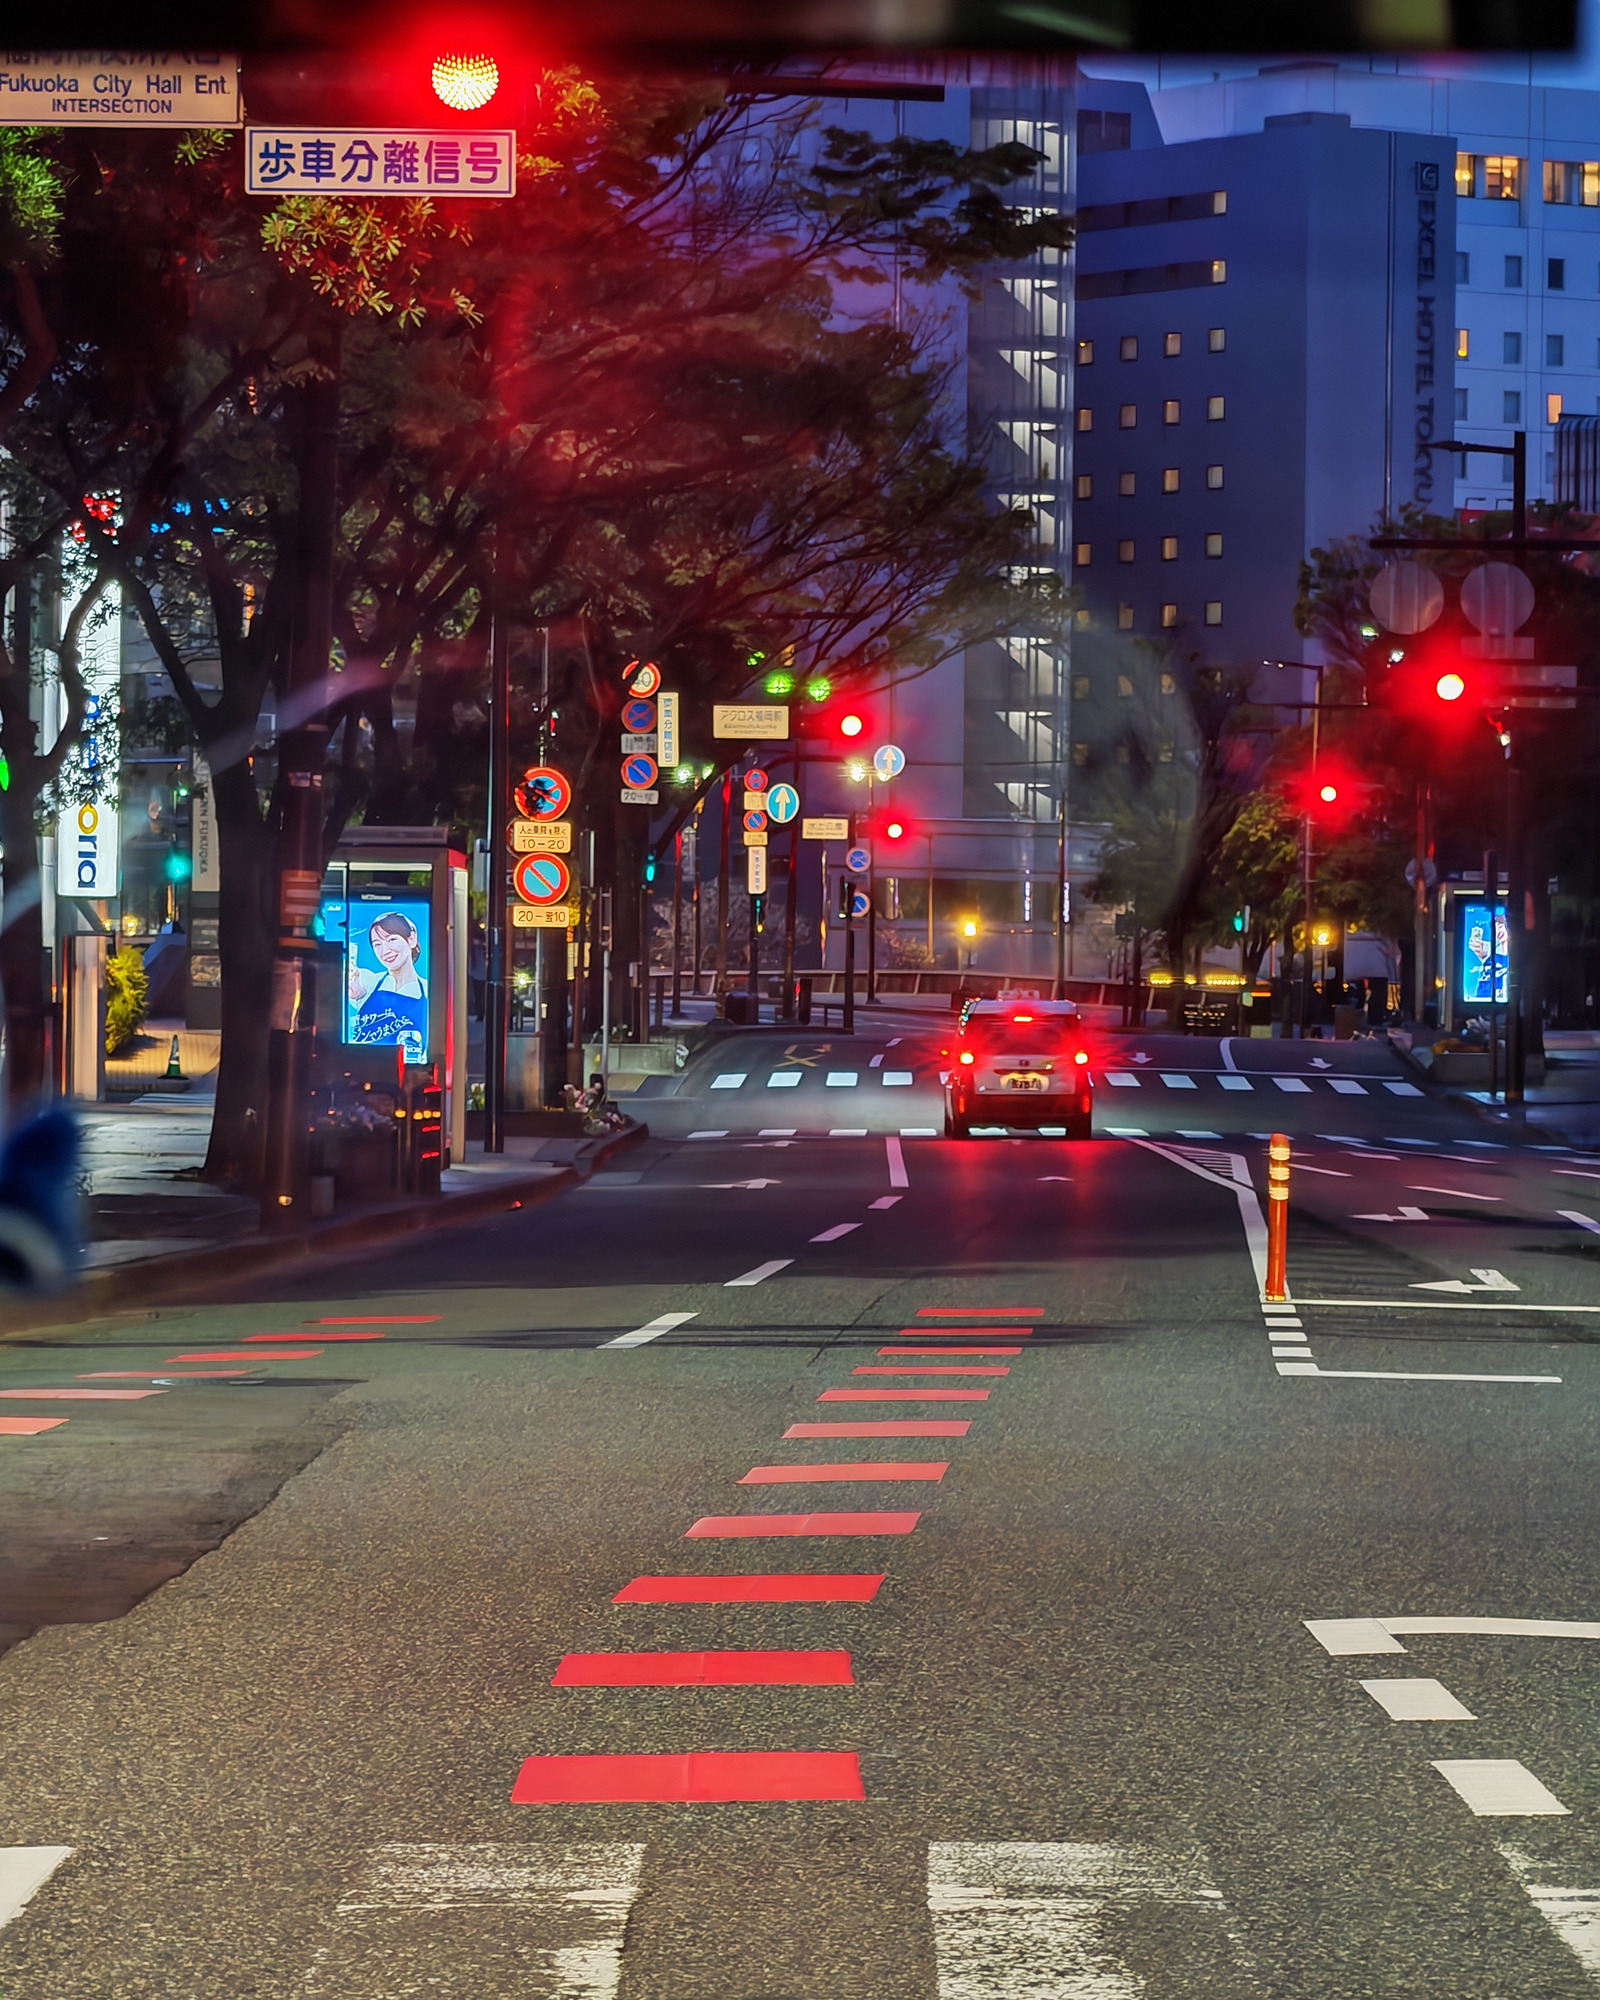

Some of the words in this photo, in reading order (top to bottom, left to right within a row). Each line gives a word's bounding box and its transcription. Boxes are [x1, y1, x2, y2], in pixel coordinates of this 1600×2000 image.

[0, 74, 79, 93] Fukuoka
[93, 74, 132, 98] City
[146, 75, 182, 94] Hall
[195, 75, 231, 95] Ent.
[52, 98, 172, 114] INTERSECTION
[258, 138, 503, 185] 歩車分離信号
[1417, 200, 1436, 288] EXCEL
[1416, 296, 1436, 395] HOTEL
[1414, 397, 1434, 503] TOKYU
[199, 820, 209, 874] FUKUOKA
[521, 838, 565, 850] 10-20
